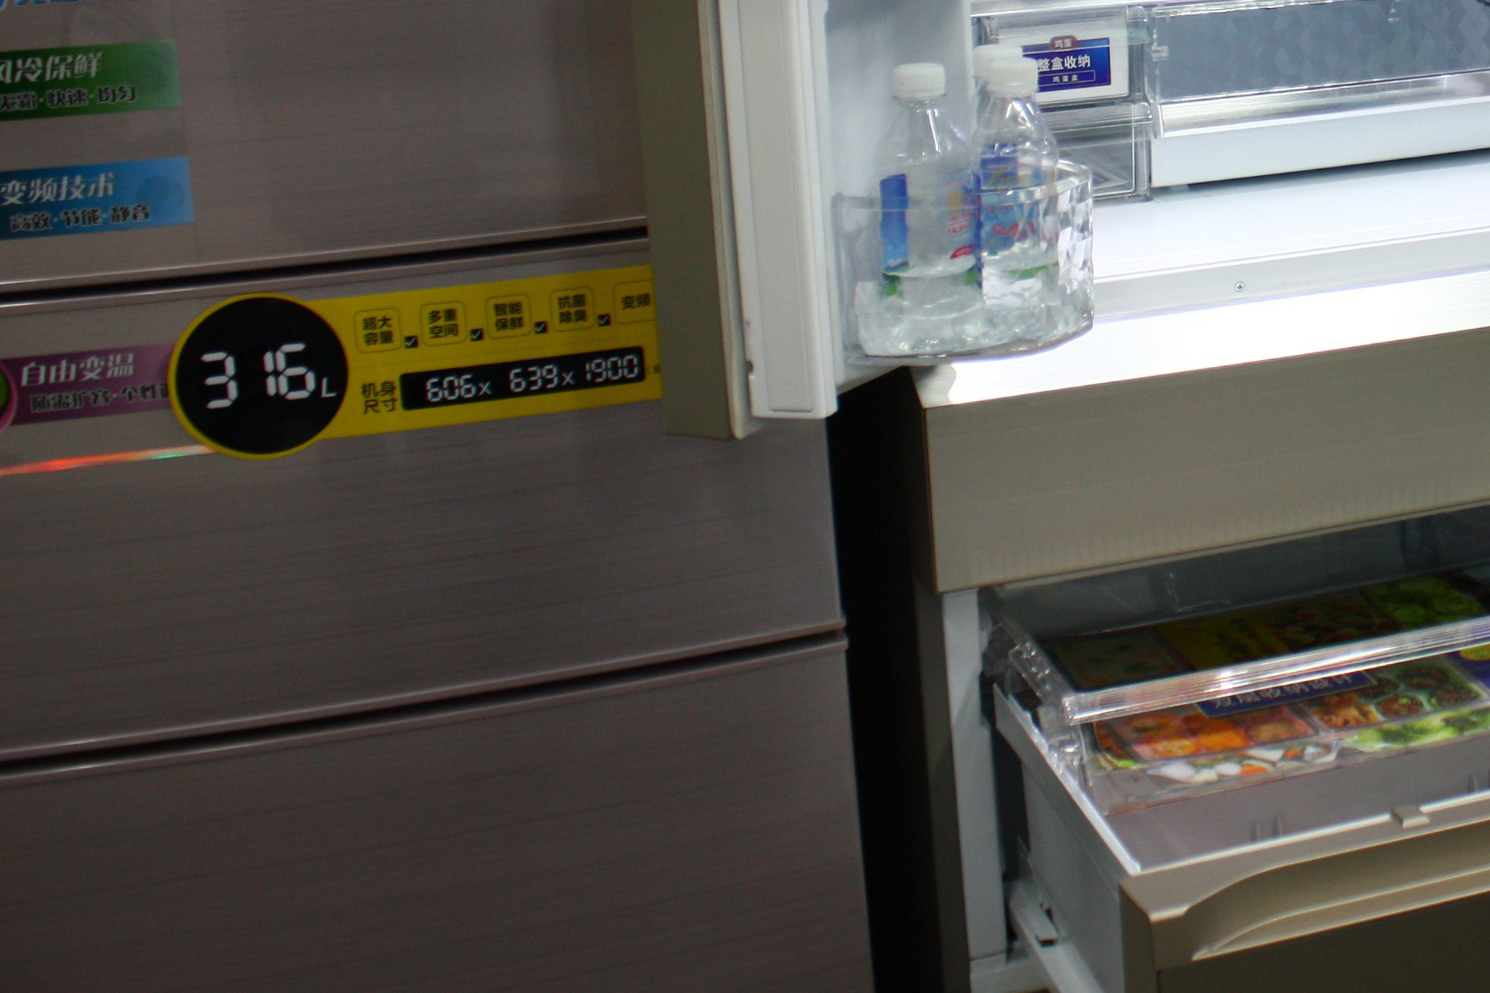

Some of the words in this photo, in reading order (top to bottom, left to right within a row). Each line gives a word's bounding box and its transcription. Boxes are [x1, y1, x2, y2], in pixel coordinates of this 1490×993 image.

[1037, 54, 1091, 72] 整盒收纳
[0, 172, 116, 207] 变频技术
[362, 315, 393, 330] 超大
[428, 308, 457, 324] 多重
[493, 301, 522, 317] 智能
[557, 294, 587, 309] 抗菌
[364, 330, 394, 346] 容量
[429, 323, 459, 339] 空间
[495, 316, 524, 332] 保鲜
[558, 309, 588, 325] 除臭
[21, 352, 135, 388] 自由变温
[585, 354, 639, 383] 1900
[361, 381, 397, 399] 机身
[362, 397, 397, 415] 尺寸
